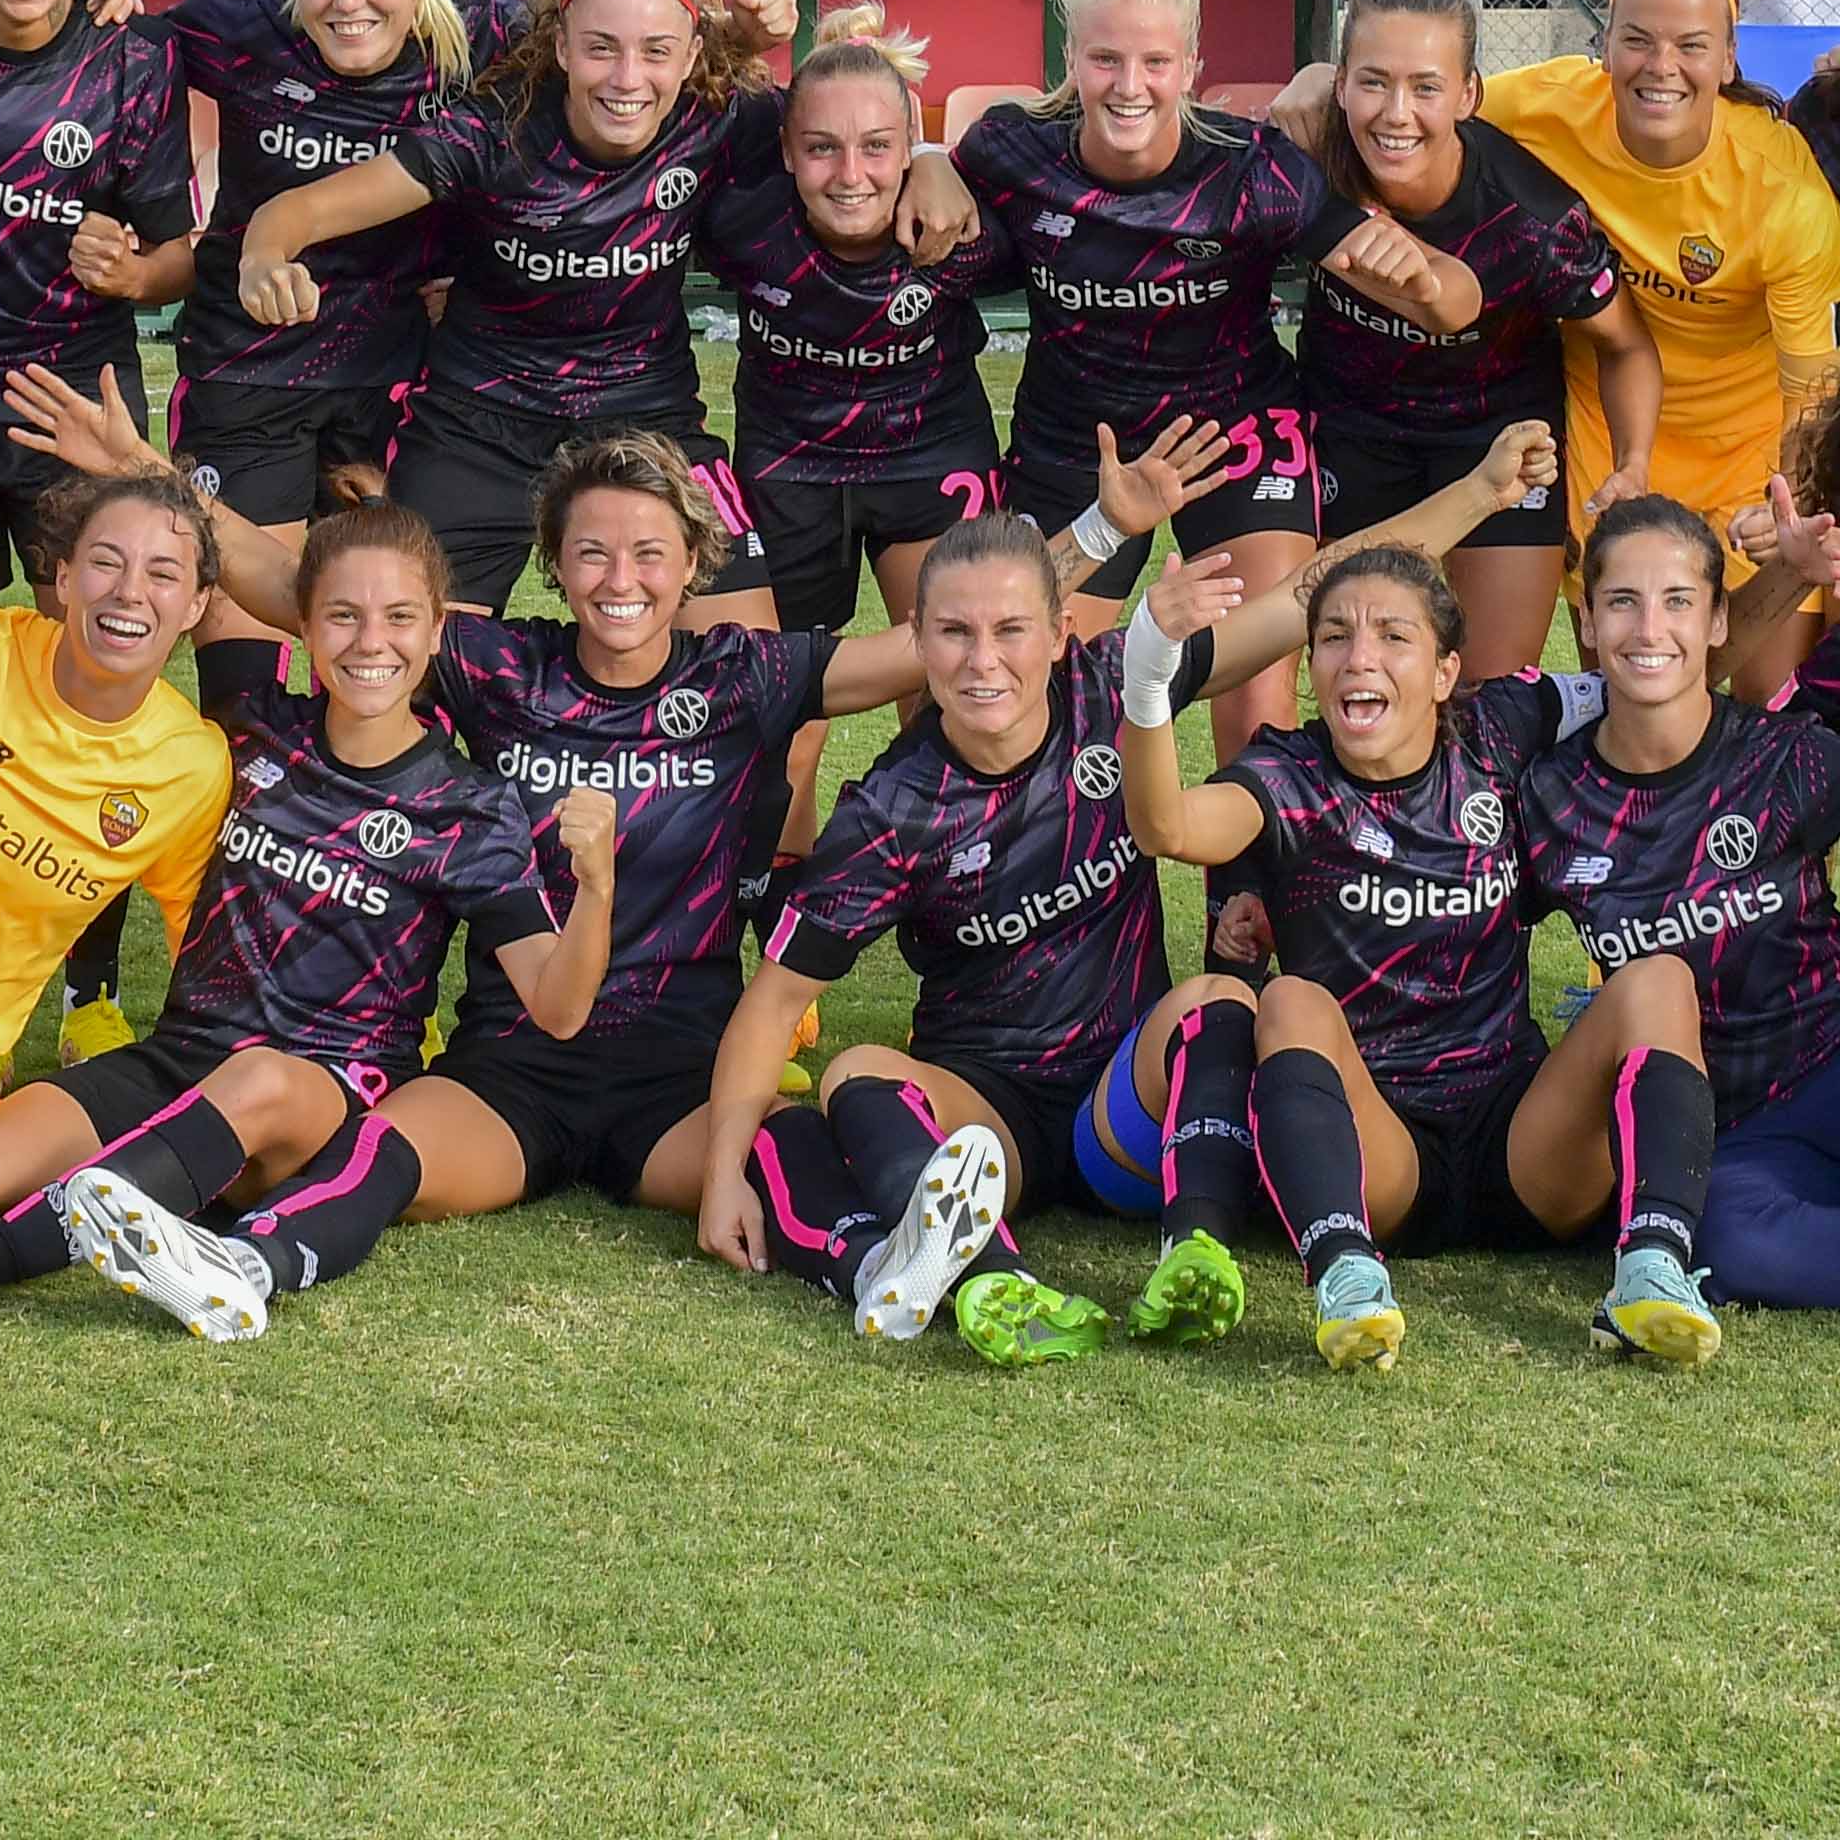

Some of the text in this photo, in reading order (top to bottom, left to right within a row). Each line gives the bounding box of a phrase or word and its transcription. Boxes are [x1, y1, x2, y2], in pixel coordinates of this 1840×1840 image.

[44, 121, 93, 168] ASR
[655, 167, 697, 210] ASR
[495, 231, 690, 281] digitalbits
[888, 285, 932, 326] ASR
[1032, 266, 1229, 310] digitalbits
[749, 310, 935, 367] digitalbits
[658, 688, 709, 738] ASR
[497, 743, 715, 793] digitalbits
[1073, 744, 1122, 799] ASR
[360, 805, 413, 859] ASR
[1460, 791, 1505, 847] ASR
[1706, 815, 1757, 869] ASR
[957, 835, 1141, 947] digitalbit
